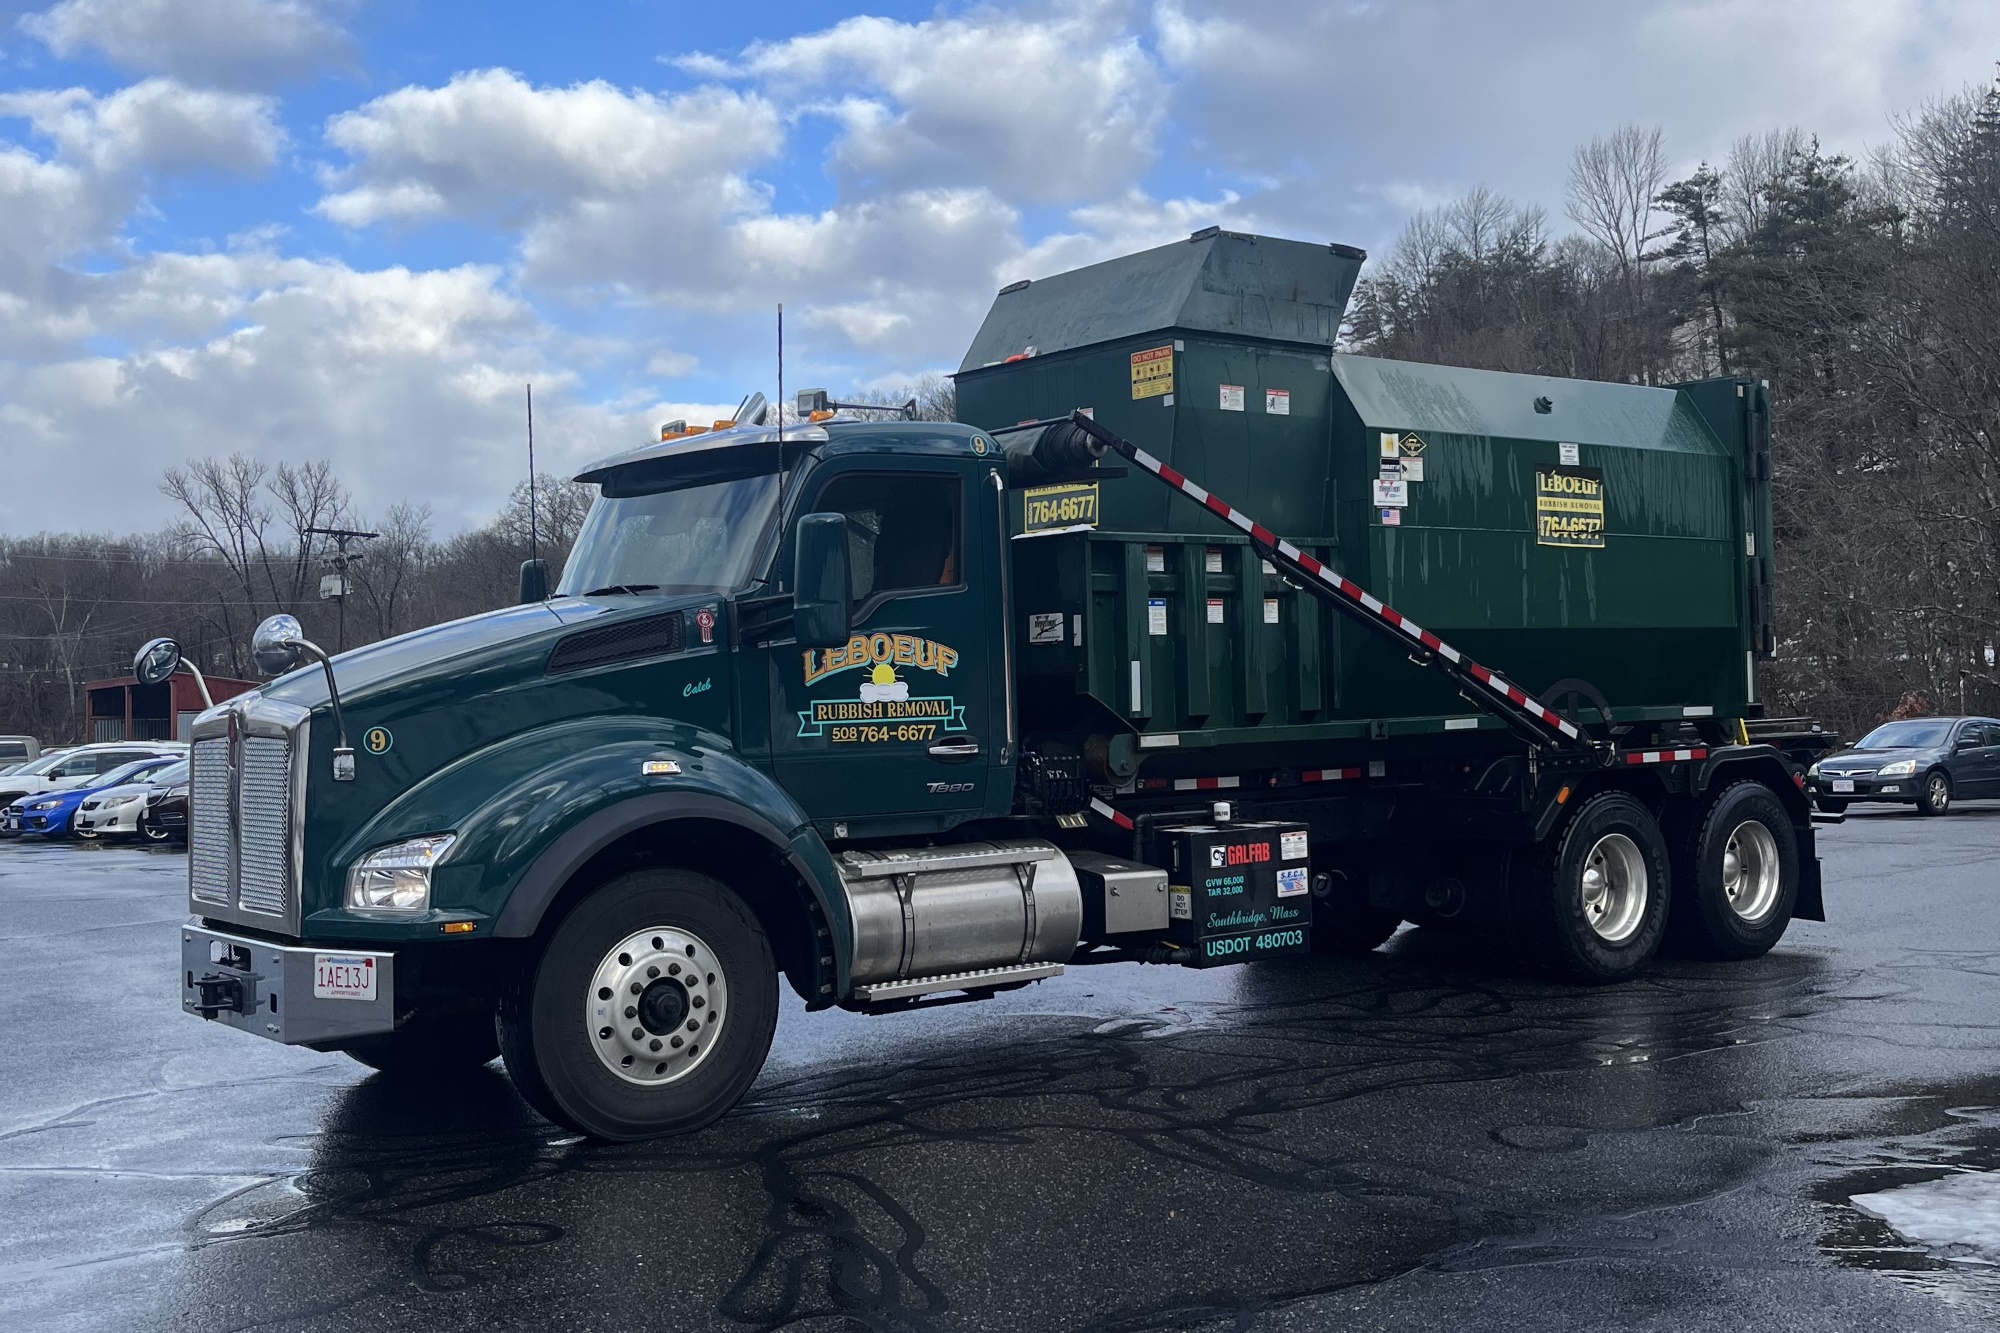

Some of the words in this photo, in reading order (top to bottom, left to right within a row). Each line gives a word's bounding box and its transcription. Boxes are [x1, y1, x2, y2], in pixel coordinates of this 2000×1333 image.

[1142, 352, 1154, 361] NOT
[974, 437, 984, 453] 9
[1033, 495, 1095, 524] 764-6677
[1570, 502, 1600, 511] REMOVAL
[1544, 516, 1600, 539] 764-6677
[802, 633, 958, 687] LEBOEUF
[683, 678, 712, 697] Caleb
[817, 702, 883, 720] RUBBISH
[887, 701, 949, 718] REMOVAL
[371, 730, 386, 751] 9
[832, 727, 858, 742] 508
[858, 724, 937, 742] 764-6677
[926, 781, 975, 794] T880
[1227, 843, 1270, 865] GALFAB
[1205, 878, 1222, 888] GVW
[1207, 887, 1221, 897] TAR
[1222, 885, 1244, 896] 32,000
[1206, 909, 1267, 929] Southbridge,
[1269, 906, 1300, 920] Mass
[1206, 937, 1251, 958] USDOT
[1255, 930, 1303, 950] 480703
[318, 966, 369, 989] 1AE13J
